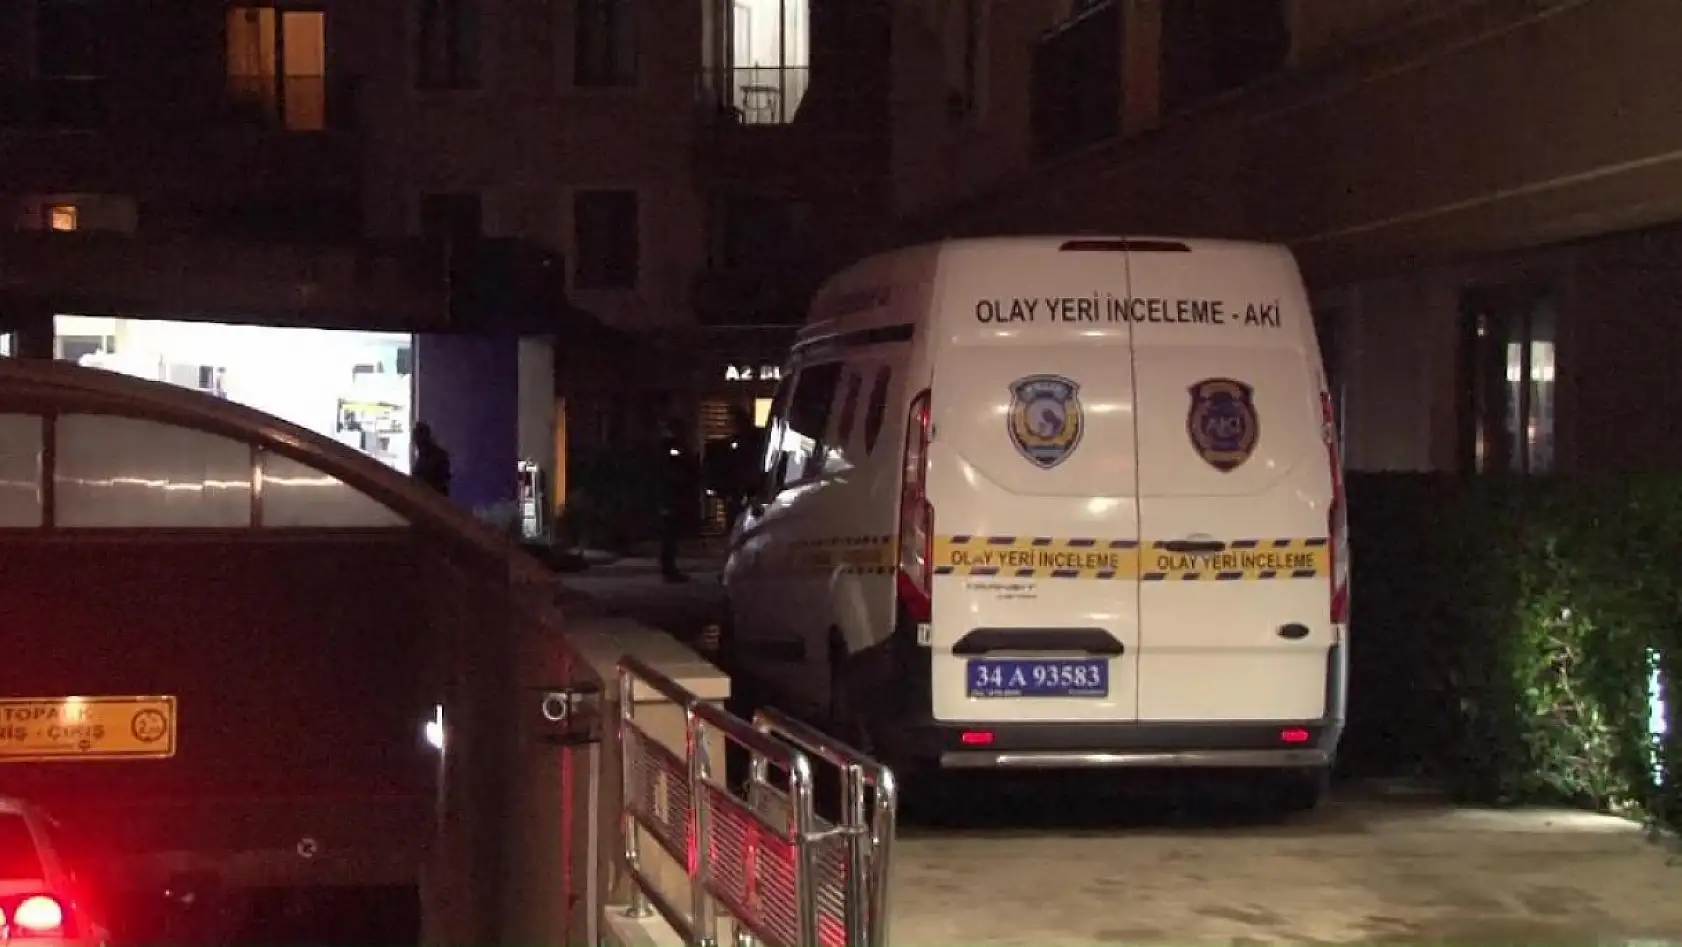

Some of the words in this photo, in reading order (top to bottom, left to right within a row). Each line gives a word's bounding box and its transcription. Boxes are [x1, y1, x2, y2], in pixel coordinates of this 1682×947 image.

[976, 298, 1038, 322] OLAY
[1045, 289, 1099, 322] YERİ
[1107, 291, 1225, 324] İNCELEME
[1245, 298, 1281, 327] AKİ
[950, 549, 993, 567] OLAY
[999, 547, 1034, 568] YERİ
[1157, 551, 1197, 570] OLAY
[976, 664, 1003, 688] 34
[1008, 665, 1027, 687] A
[1032, 664, 1102, 688] 93583
